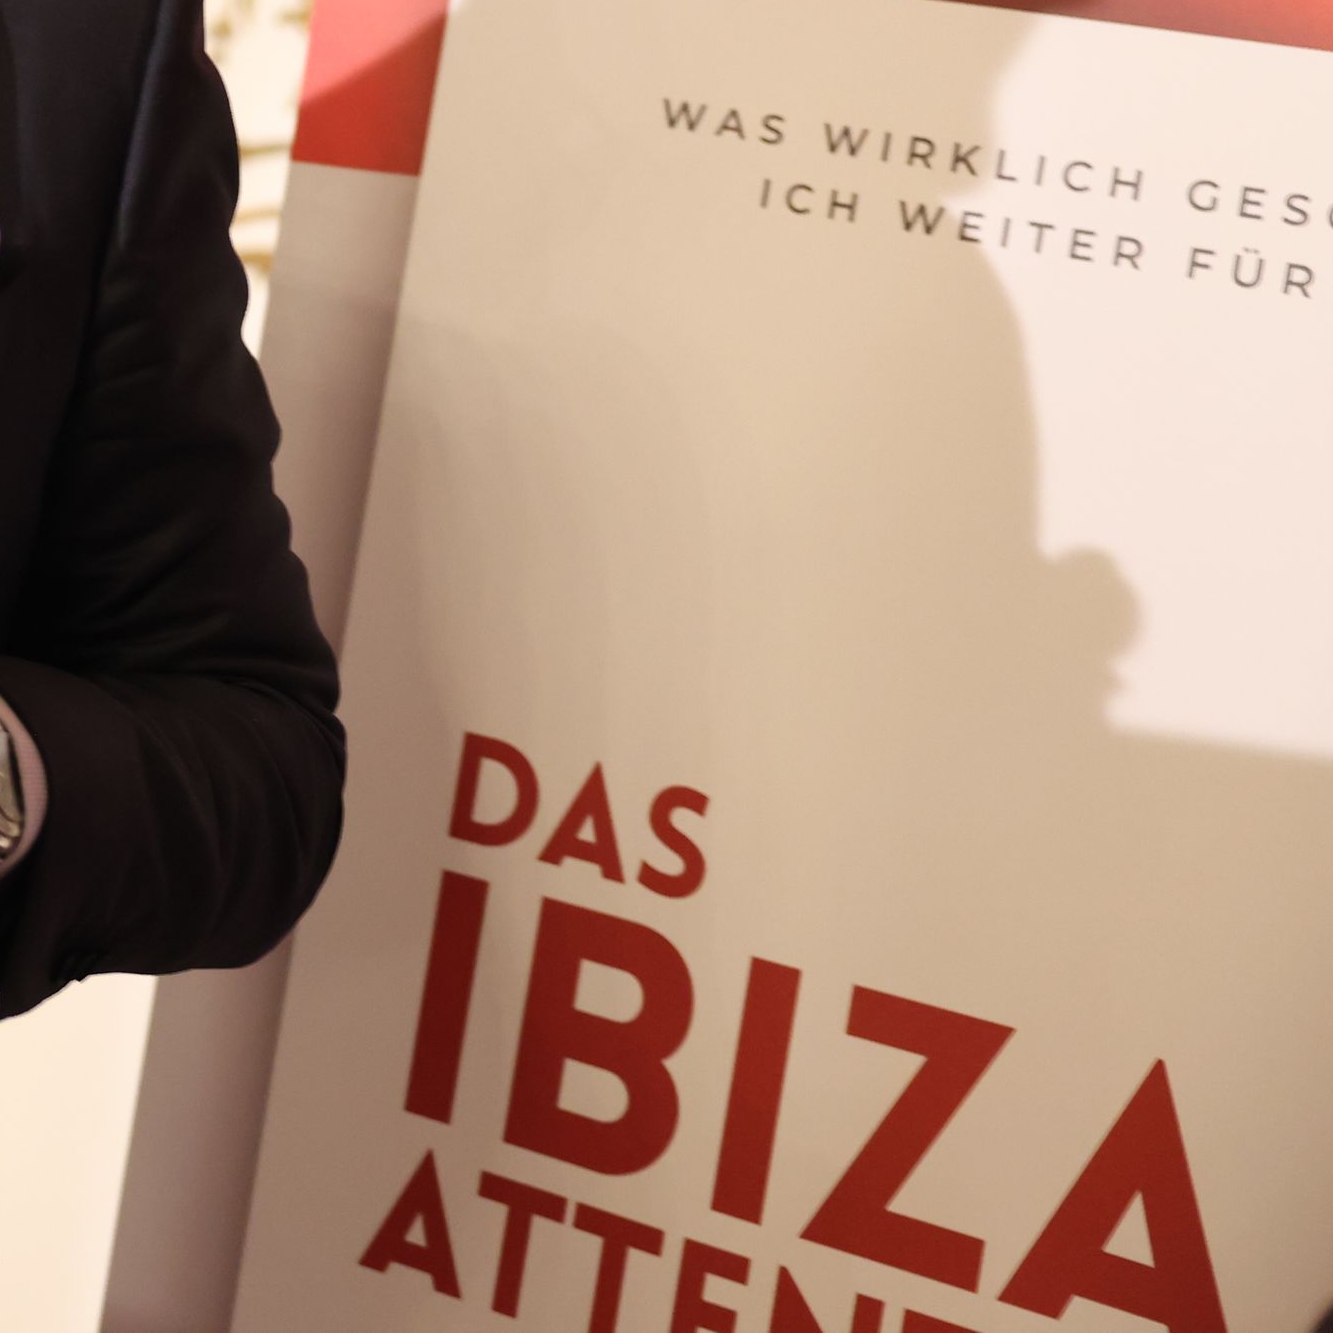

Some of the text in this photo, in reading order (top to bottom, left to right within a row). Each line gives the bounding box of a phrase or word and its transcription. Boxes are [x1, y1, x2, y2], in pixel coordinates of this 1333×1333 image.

[661, 96, 1333, 230] WAS WIRKLICH GES
[758, 177, 1315, 299] ICH WEITER FÜR
[448, 730, 710, 899] DAS
[404, 869, 1229, 1333] IBIZA
[357, 1148, 985, 1333] ATTE
